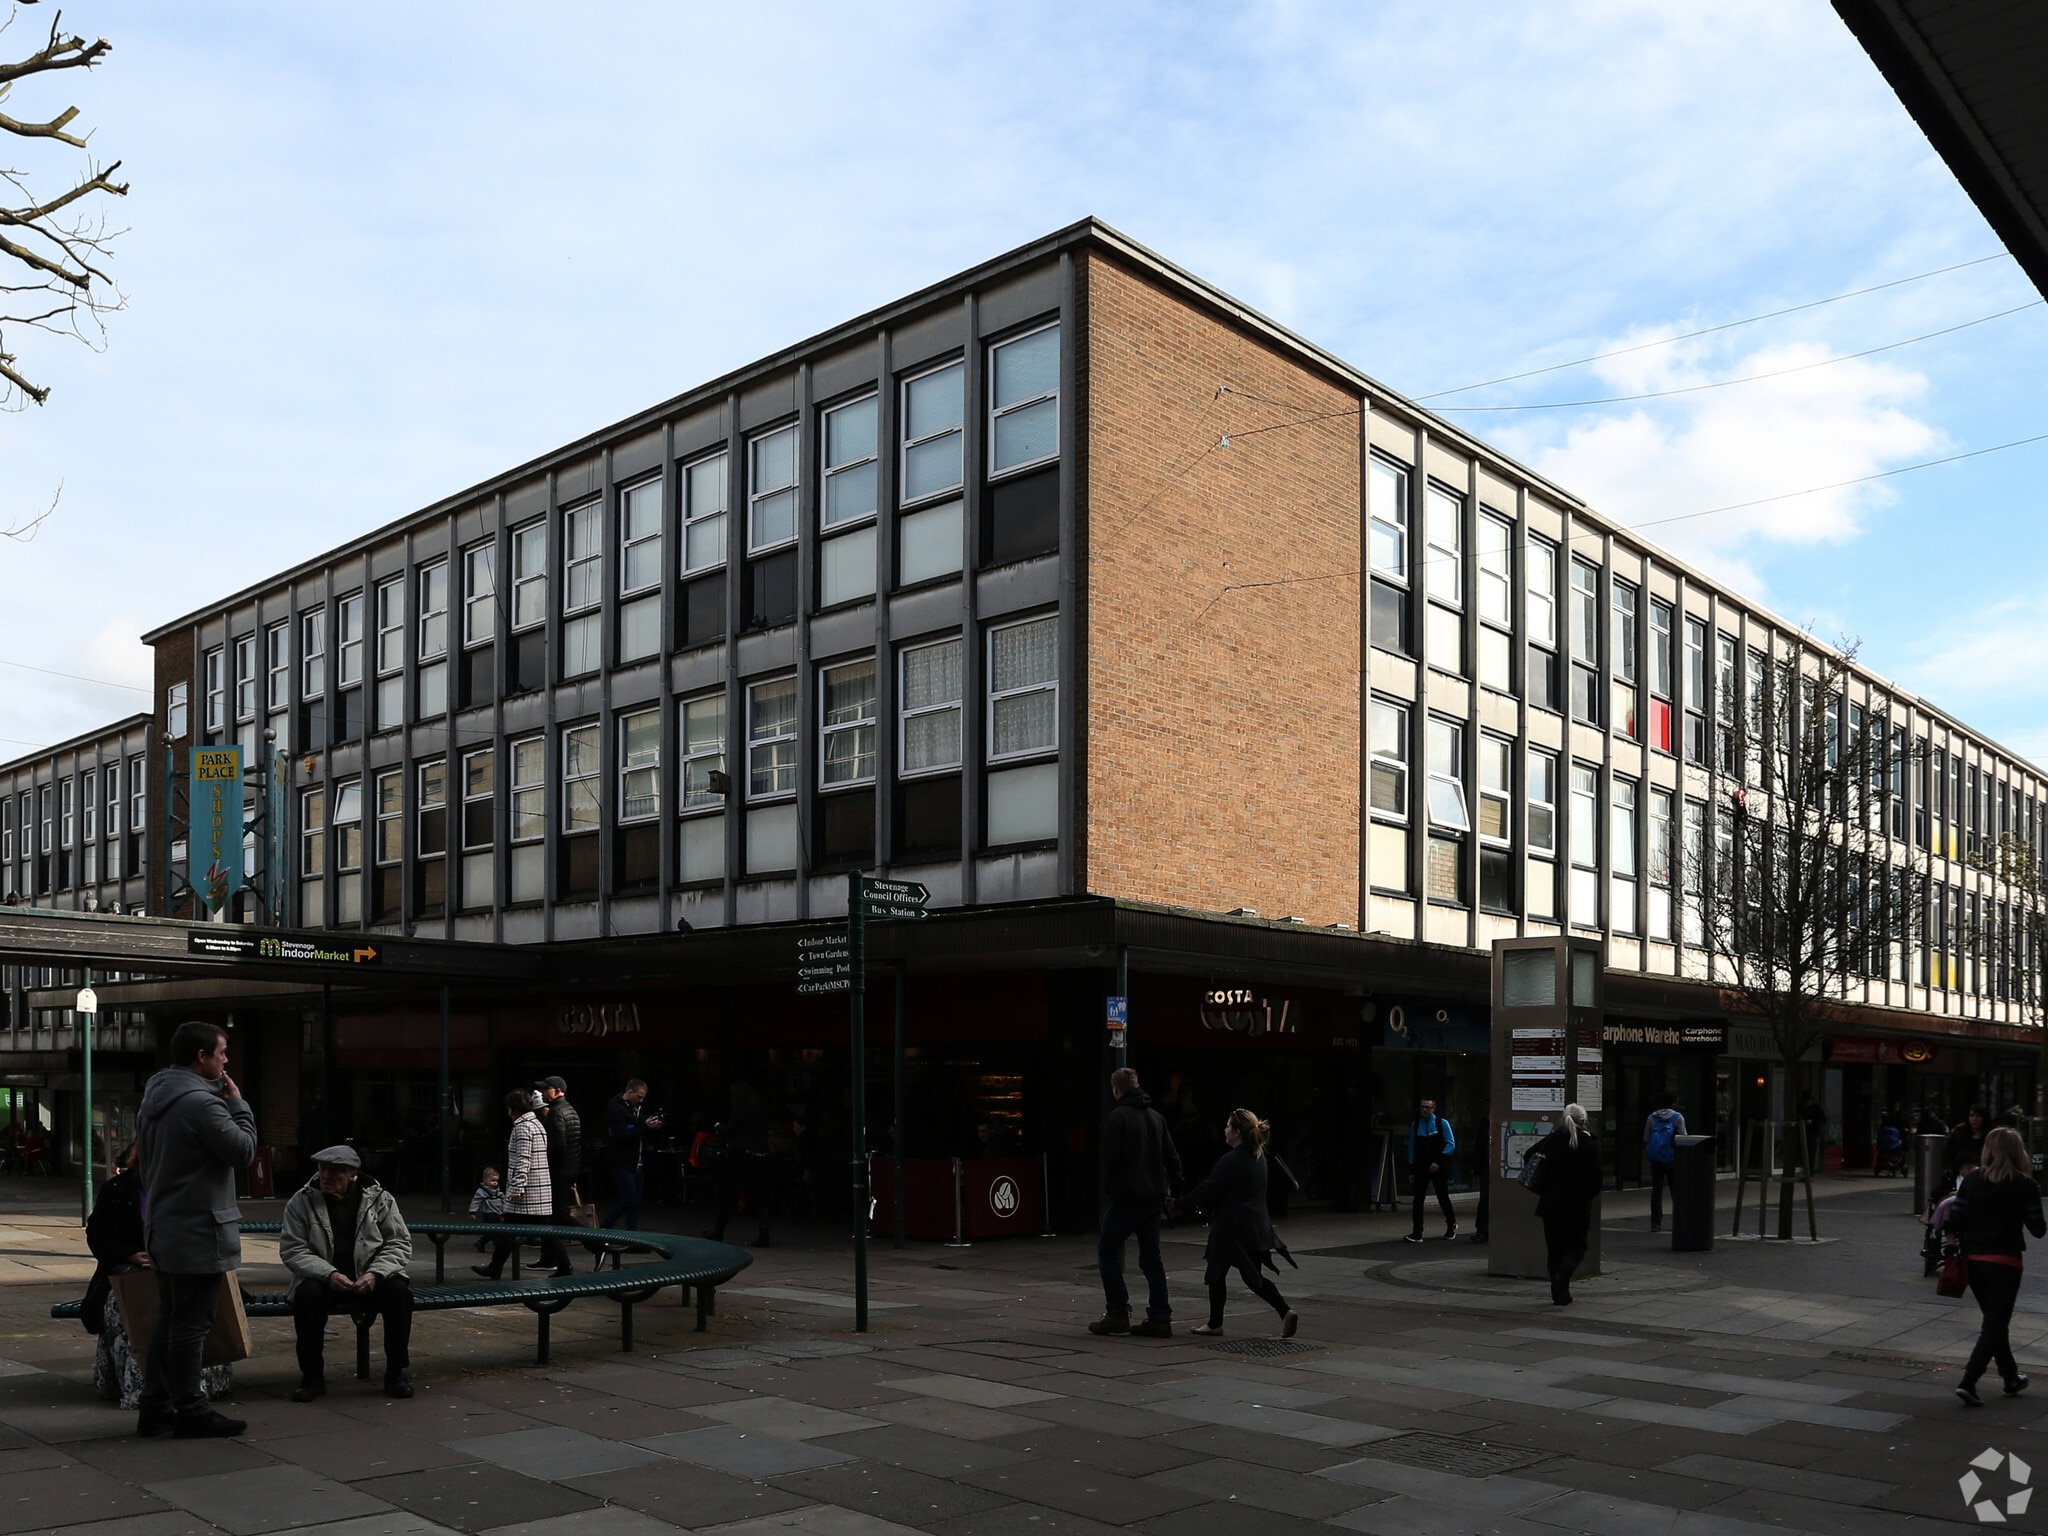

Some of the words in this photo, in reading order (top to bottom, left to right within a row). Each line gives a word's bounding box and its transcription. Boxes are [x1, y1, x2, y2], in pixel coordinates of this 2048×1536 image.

[201, 753, 232, 765] PARK
[198, 766, 235, 779] PLACE
[211, 784, 223, 860] SHOPS
[874, 880, 909, 894] Stevenage
[863, 889, 892, 901] Council
[893, 893, 919, 903] Offices
[890, 906, 915, 917] Station
[281, 941, 315, 951] Stevenage
[804, 937, 824, 947] Indoor
[825, 936, 847, 945] Market
[809, 951, 825, 960] Town
[825, 949, 849, 959] Gardens
[803, 965, 834, 976] Swimming
[836, 963, 850, 973] Pool
[1205, 989, 1254, 1006] COSTA
[557, 1002, 641, 1038] COSTA
[1602, 1023, 1644, 1045] arphone
[1644, 1027, 1680, 1045] Wareho
[1685, 1027, 1723, 1036] Carphone
[1681, 1035, 1723, 1043] Warehouse
[1735, 1033, 1756, 1052] MAD
